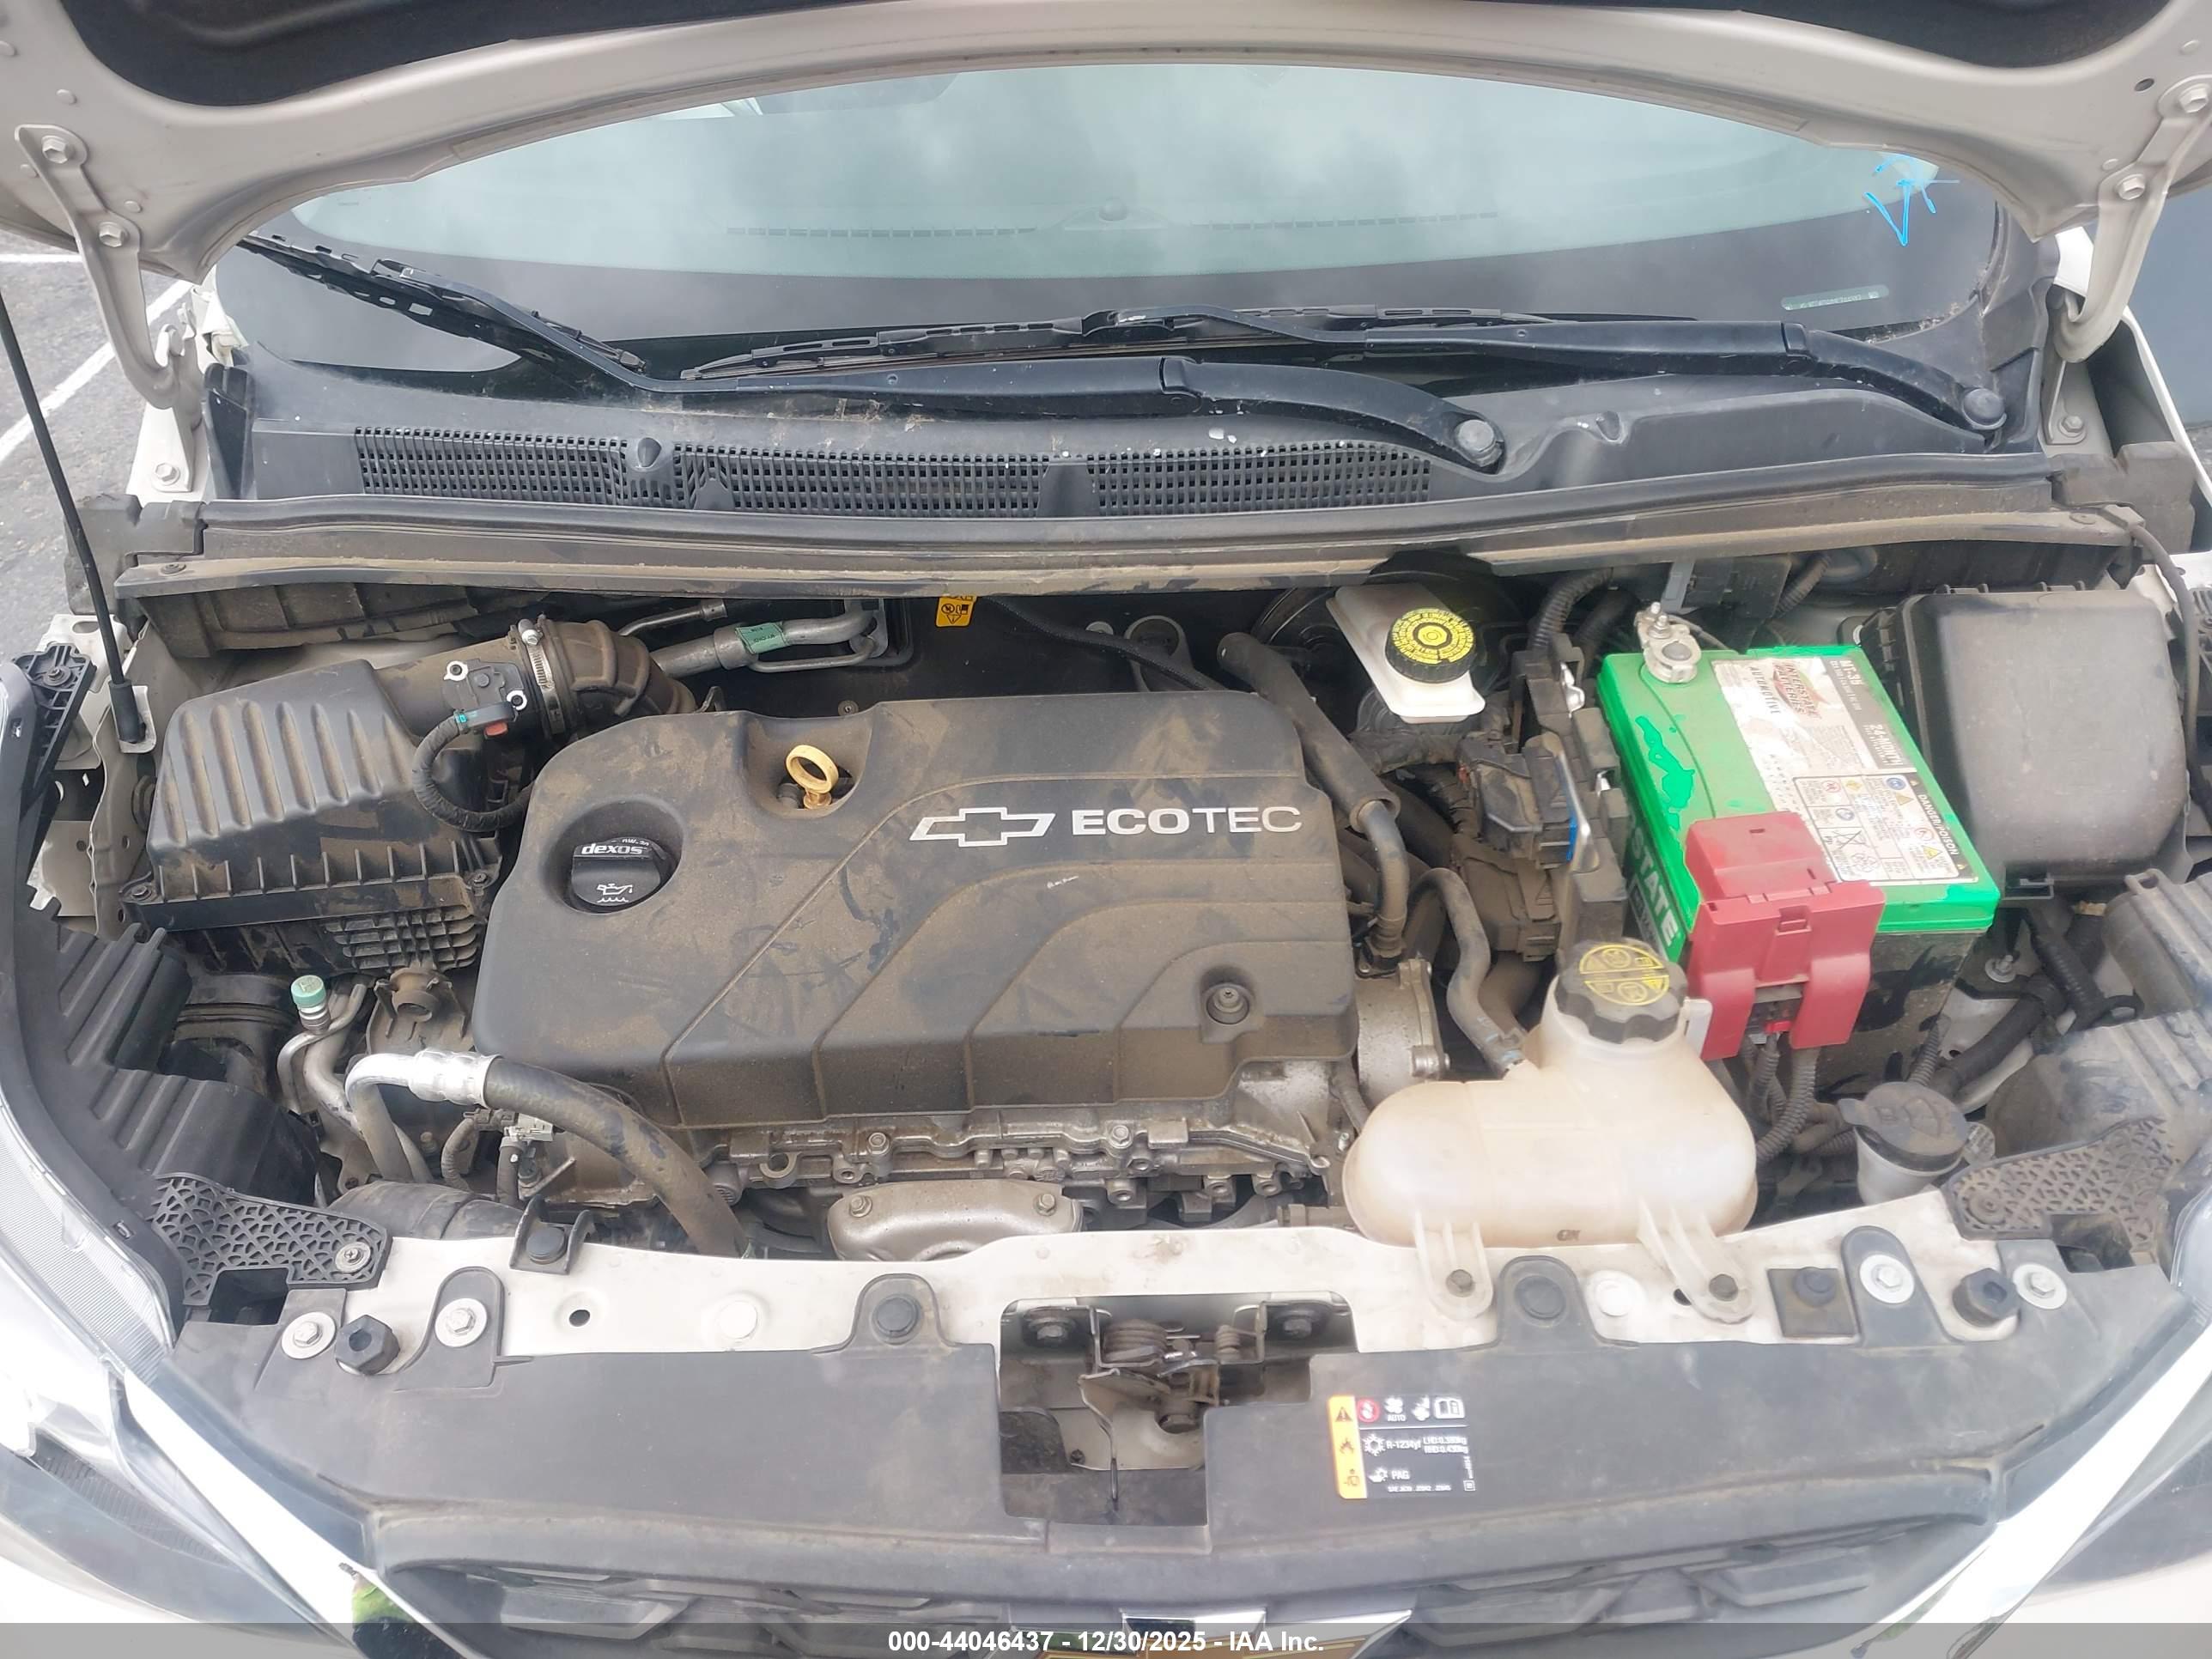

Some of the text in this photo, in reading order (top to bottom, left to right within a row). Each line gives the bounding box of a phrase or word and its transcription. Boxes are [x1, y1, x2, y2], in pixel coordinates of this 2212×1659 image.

[1749, 666, 1782, 714] AUTOMOTIVE
[1873, 724, 1904, 765] 24-MONTH
[1072, 806, 1302, 836] ECOTEC
[1918, 794, 1959, 855] DANGER/POISON
[581, 843, 644, 854] dexos
[1386, 1441, 1422, 1451] R-1234yf
